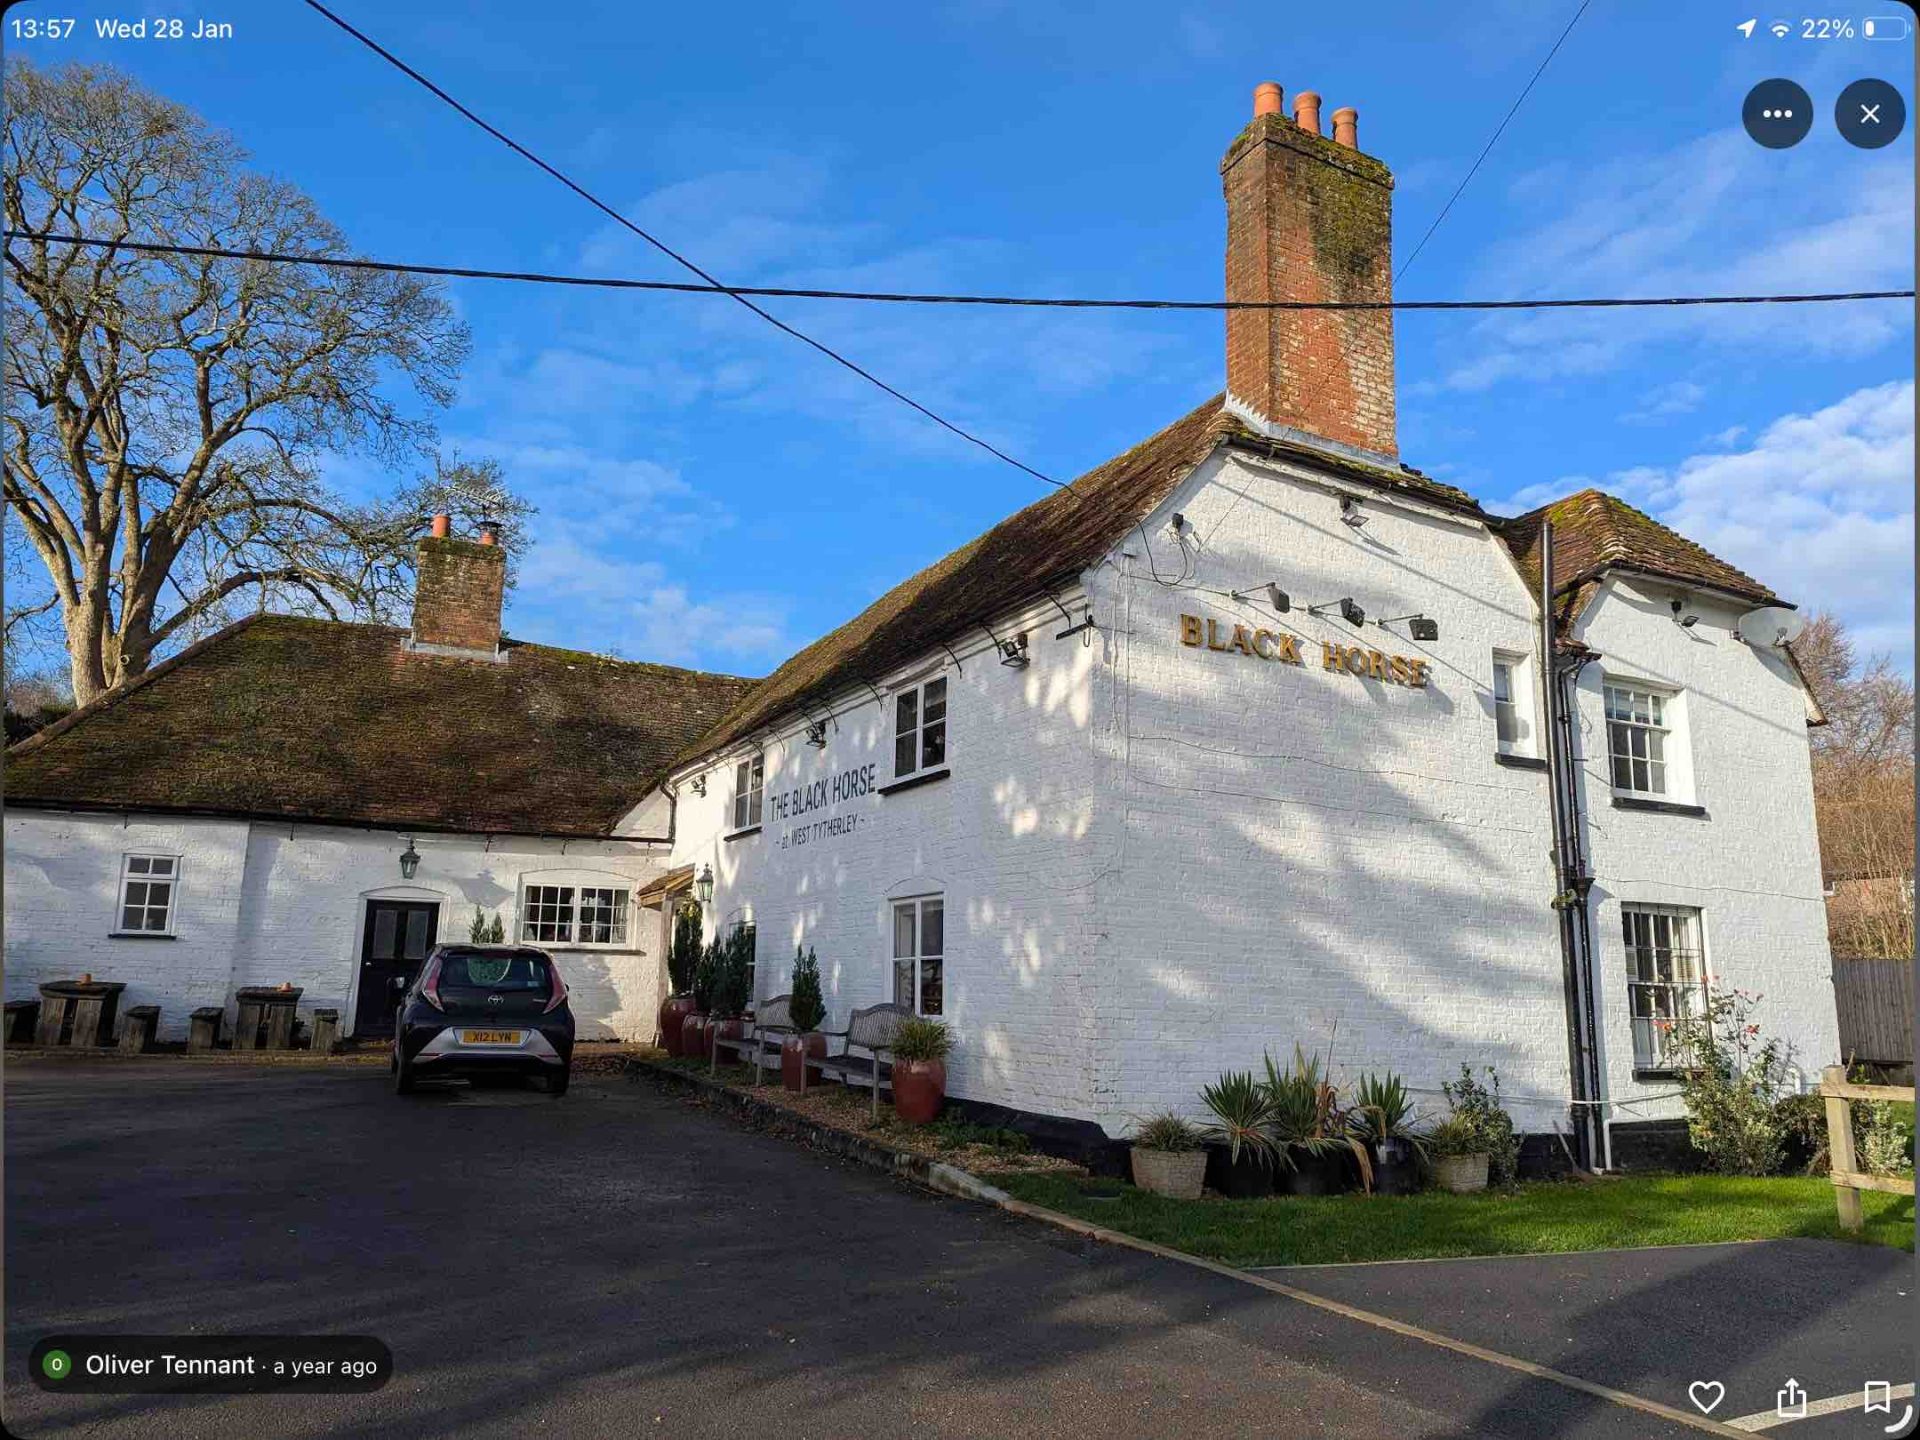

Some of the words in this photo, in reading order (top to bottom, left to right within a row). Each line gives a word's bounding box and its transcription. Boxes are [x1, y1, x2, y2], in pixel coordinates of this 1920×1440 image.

[1179, 613, 1301, 666] BLACK
[1321, 640, 1428, 688] HORSE
[771, 792, 789, 822] THE
[791, 778, 829, 817] BLACK
[832, 763, 876, 804] HORSE
[791, 825, 811, 847] WEST
[813, 813, 858, 841] TYTHERLEY
